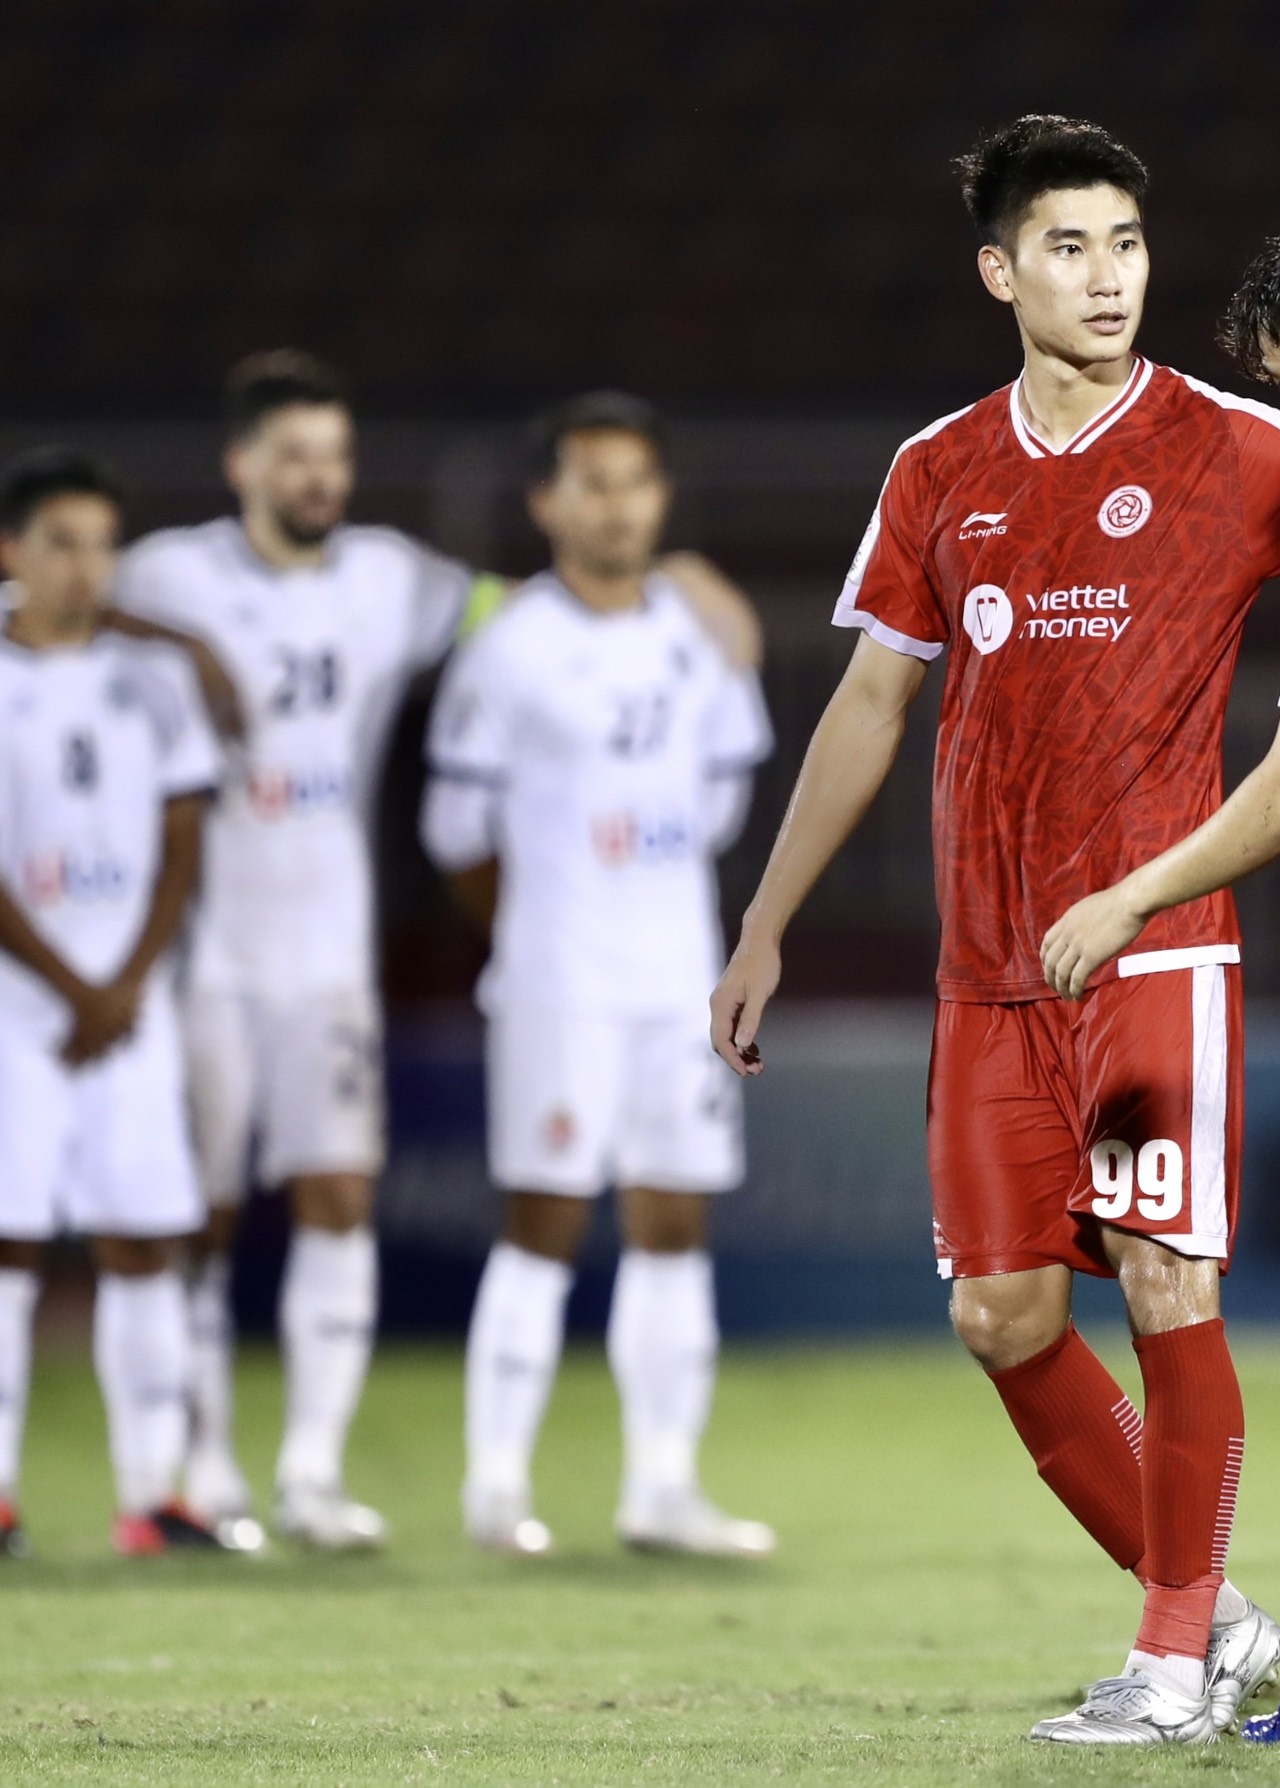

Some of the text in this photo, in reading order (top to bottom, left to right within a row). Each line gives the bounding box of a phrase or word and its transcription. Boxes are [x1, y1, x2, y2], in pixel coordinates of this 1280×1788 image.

[958, 525, 1008, 540] LI-NING
[1025, 583, 1130, 612] viettel
[1018, 615, 1132, 643] money
[1089, 1138, 1184, 1222] 99
